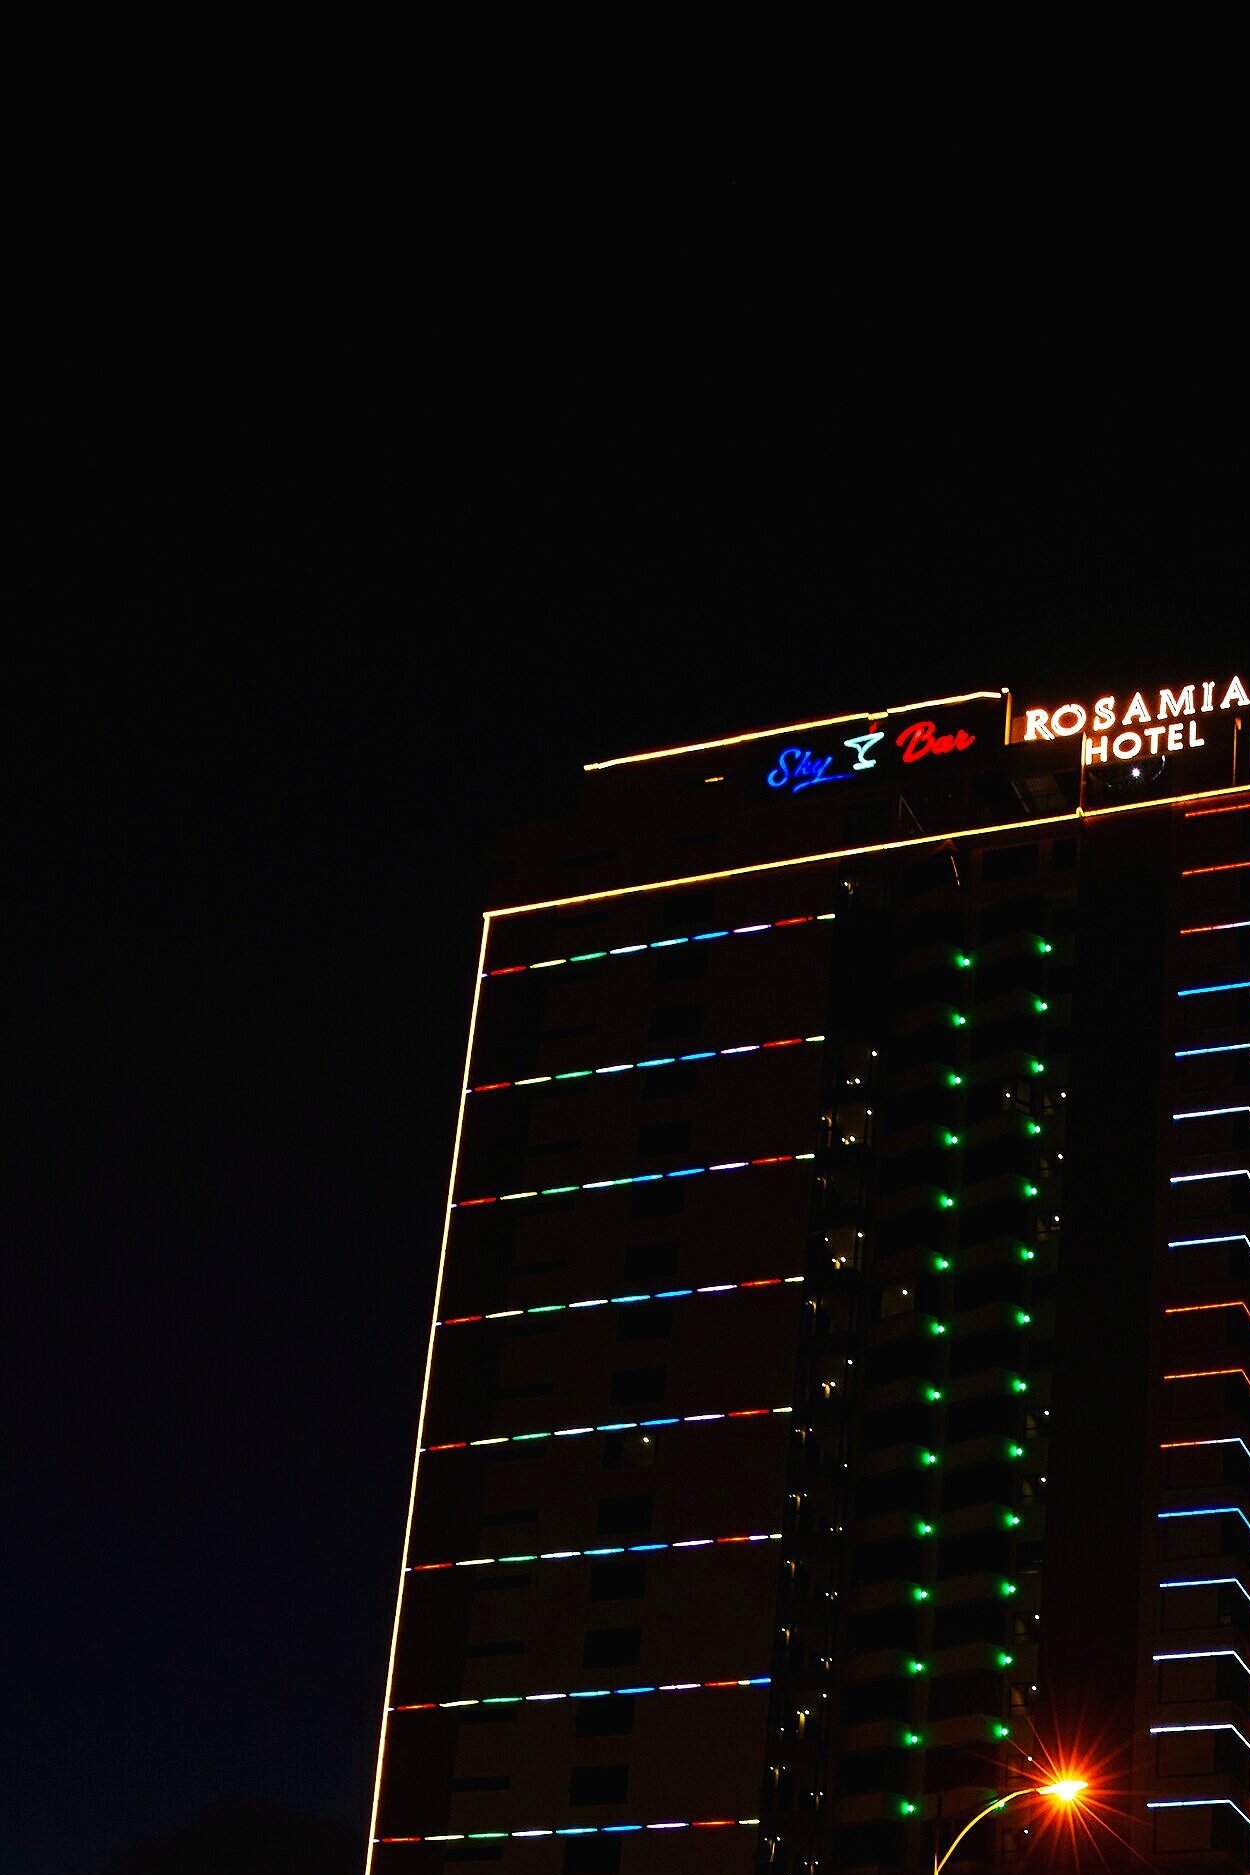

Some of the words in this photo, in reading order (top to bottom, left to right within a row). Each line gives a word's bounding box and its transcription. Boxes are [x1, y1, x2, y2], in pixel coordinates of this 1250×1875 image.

[1023, 675, 1250, 741] ROSAMIA
[767, 746, 850, 793] Sky
[896, 721, 975, 763] Bar
[1085, 720, 1205, 766] HOTEL
